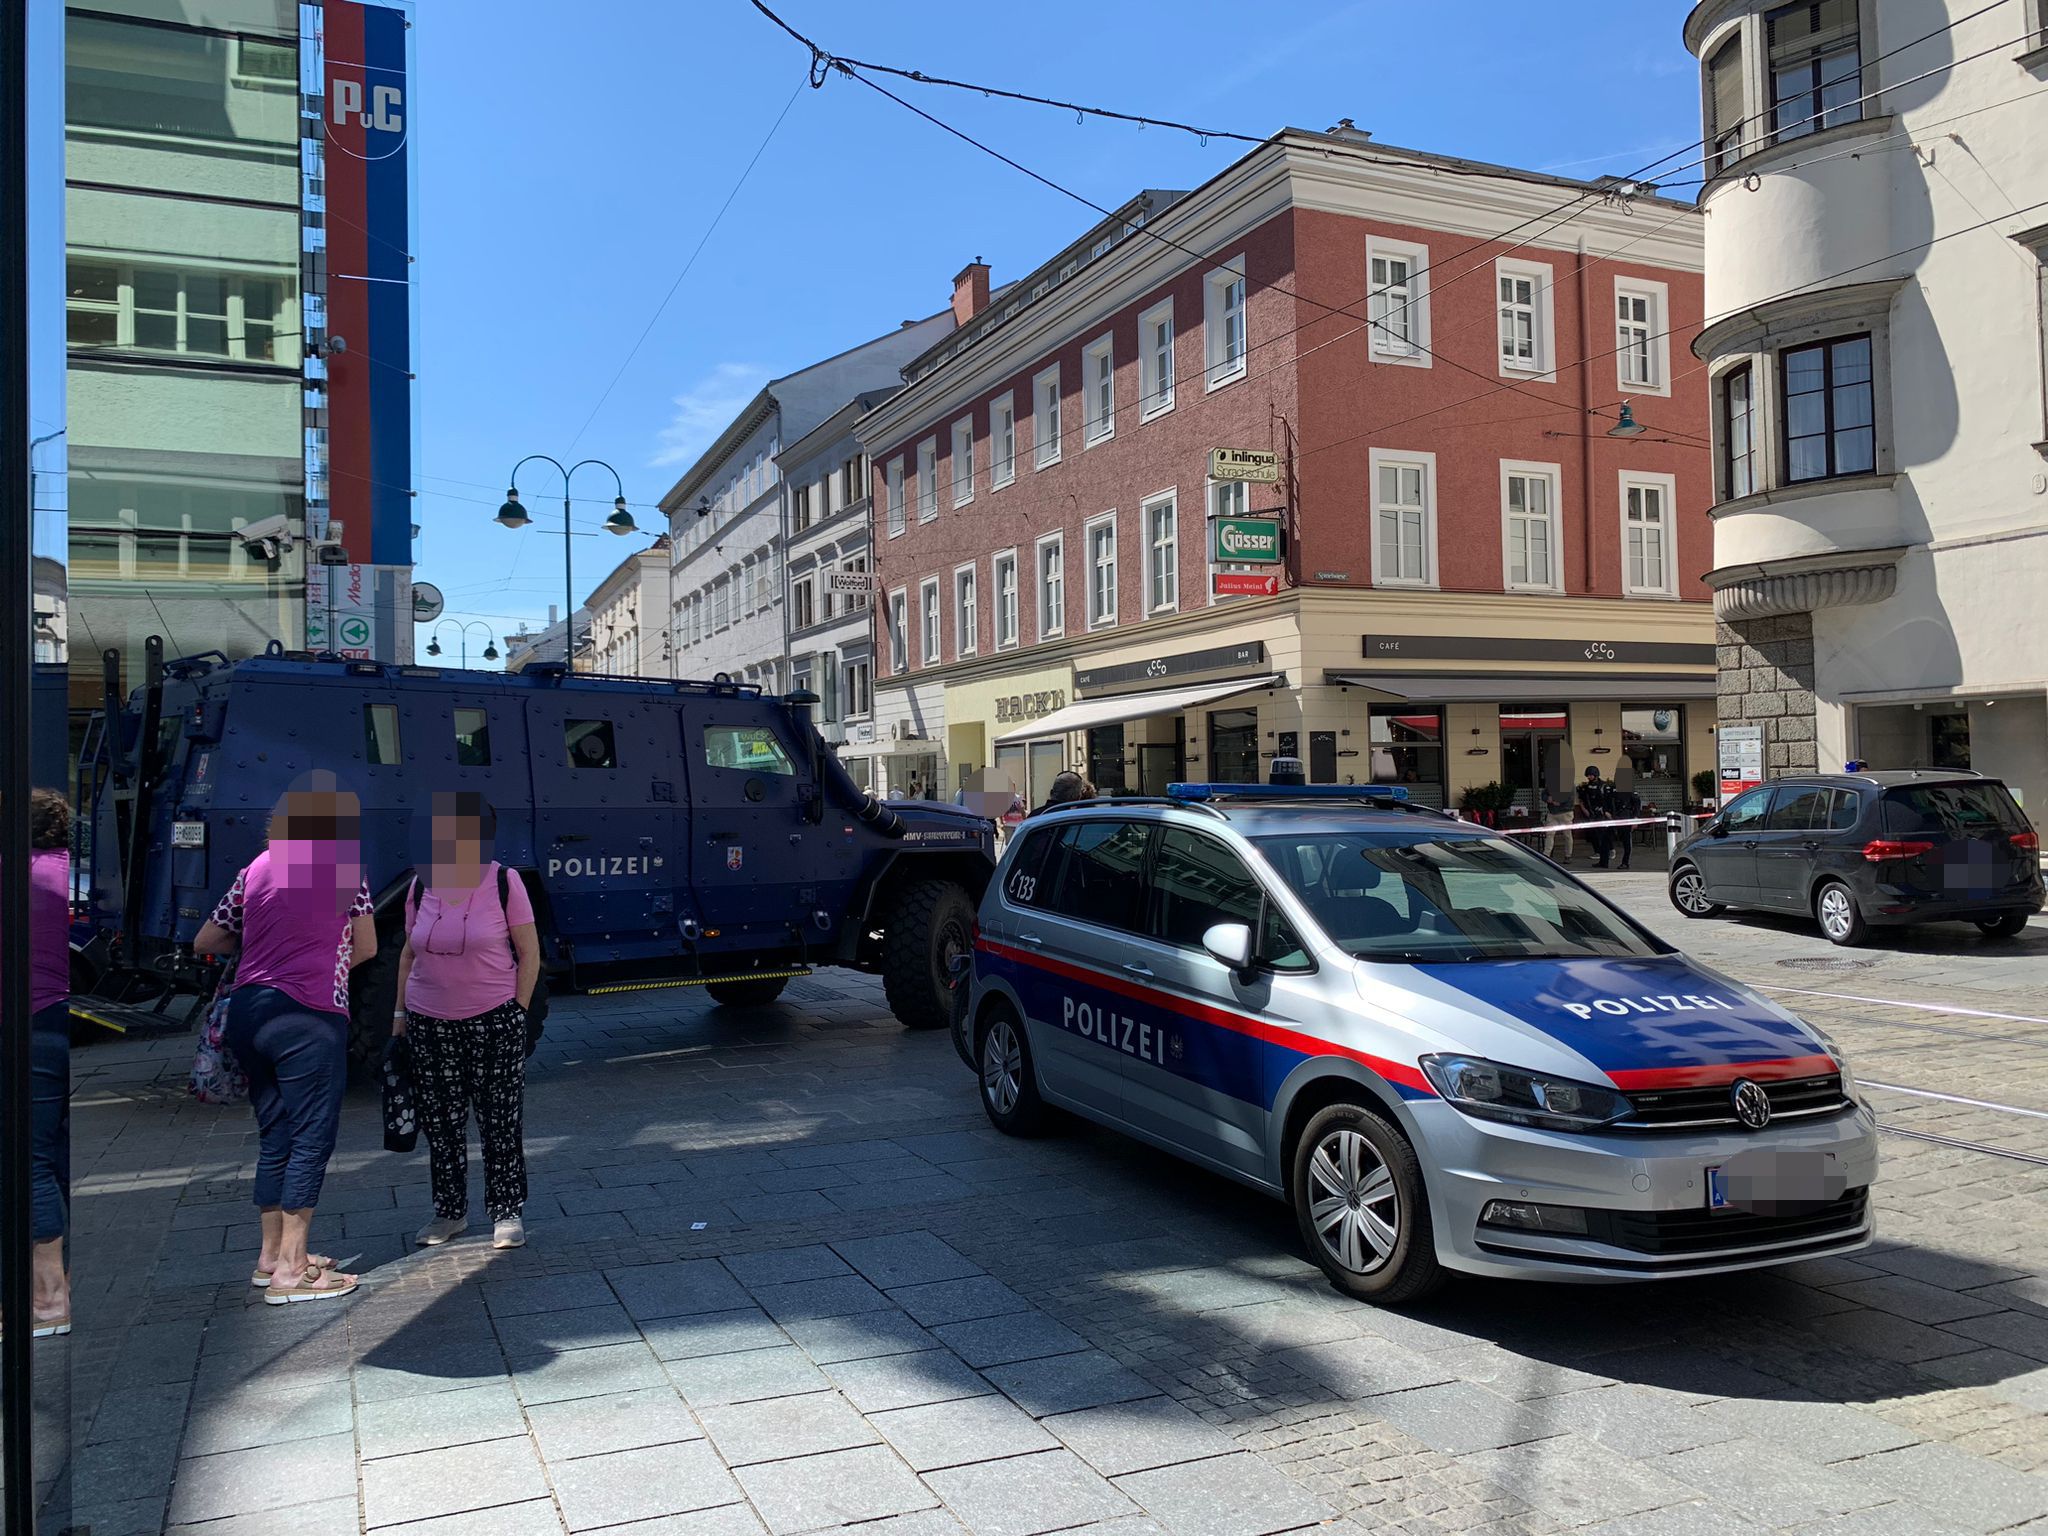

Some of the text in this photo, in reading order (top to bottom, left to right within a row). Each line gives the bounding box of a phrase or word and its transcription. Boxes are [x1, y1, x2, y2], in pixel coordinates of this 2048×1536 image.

[1231, 450, 1275, 466] inlingua
[1216, 464, 1276, 479] Sprachschule
[1220, 524, 1274, 554] Gösser
[1219, 582, 1241, 590] Julius
[1237, 650, 1249, 659] BAR
[1379, 641, 1400, 650] CAFÉ
[1584, 642, 1615, 660] ECCO
[1146, 659, 1167, 677] ECCO
[548, 856, 649, 877] POLIZEI
[1016, 875, 1037, 901] 133
[1562, 995, 1735, 1020] POLIZEI
[1063, 996, 1164, 1065] POLIZEI
